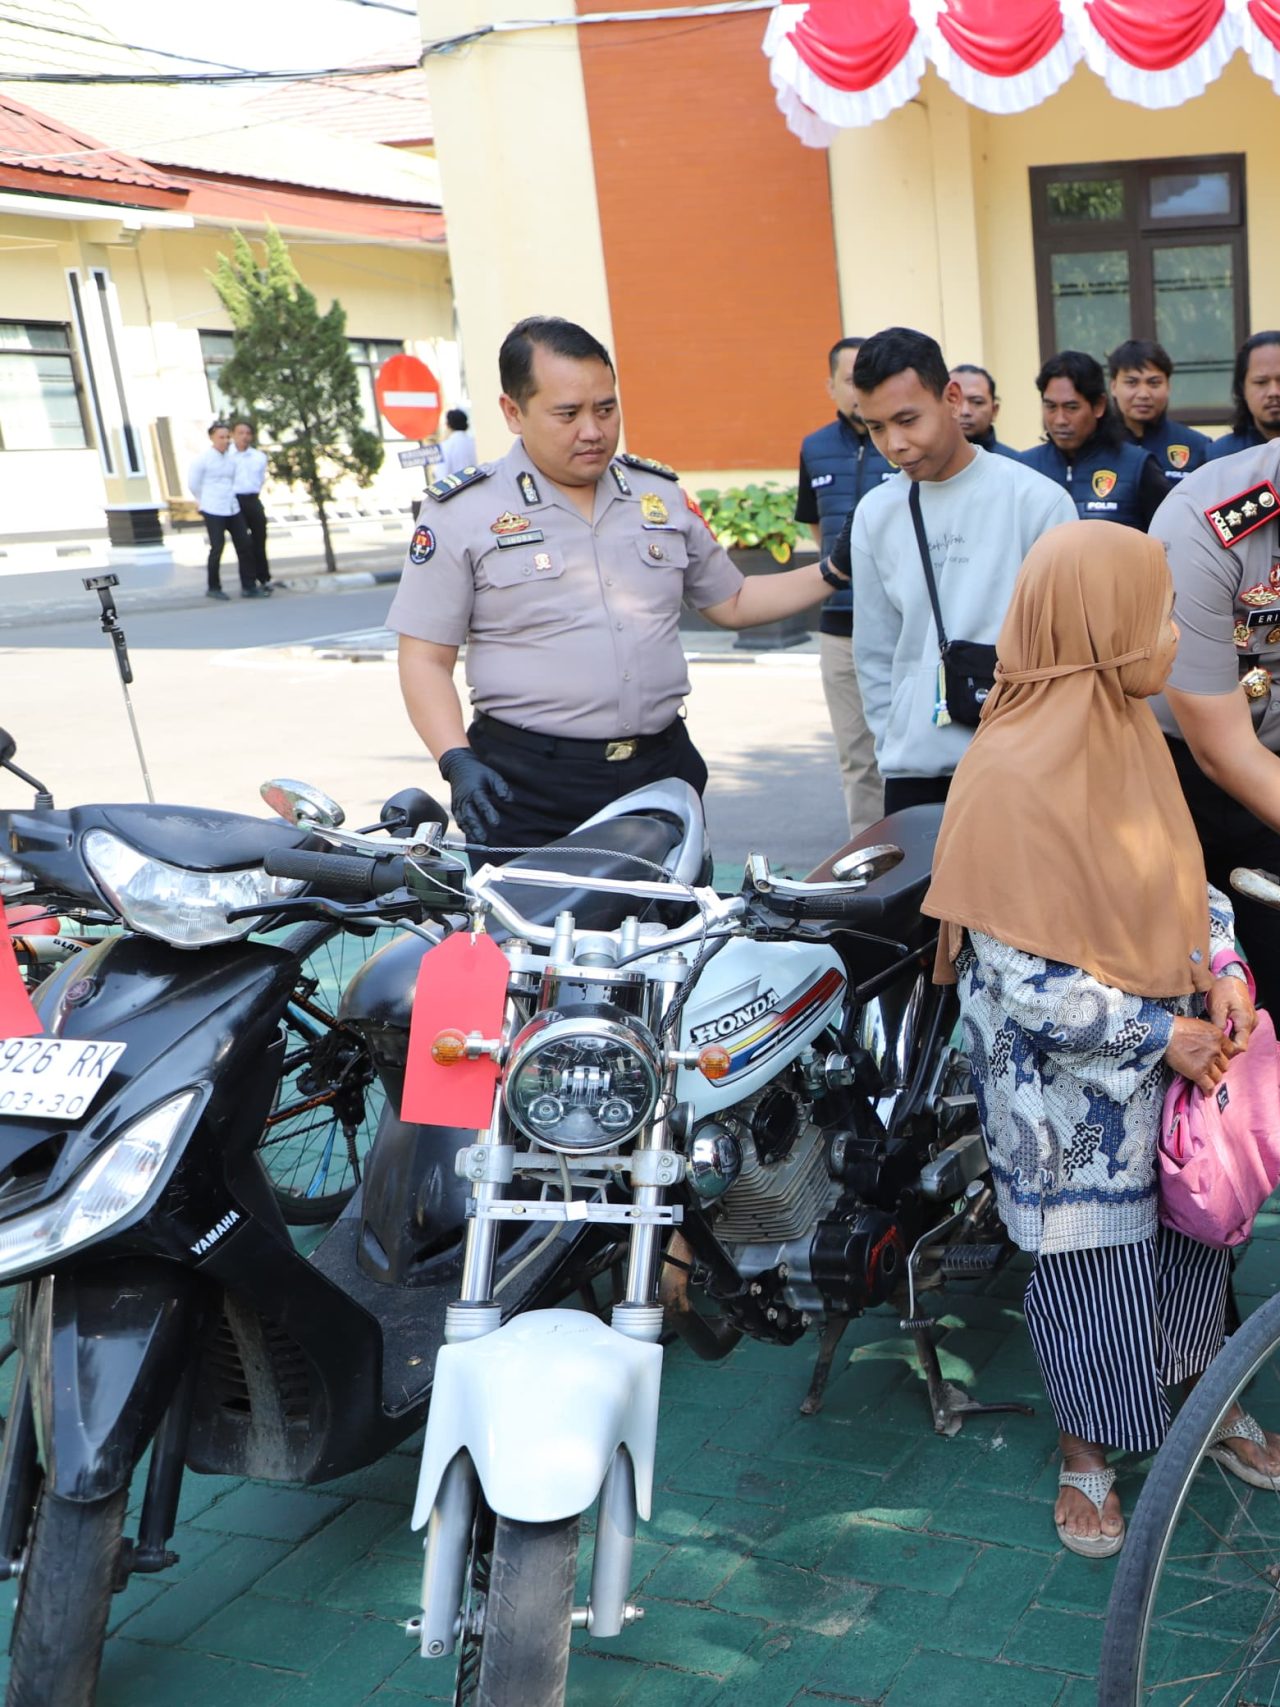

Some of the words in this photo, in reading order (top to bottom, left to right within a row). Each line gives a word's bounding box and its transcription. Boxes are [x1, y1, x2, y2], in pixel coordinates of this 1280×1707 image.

[1087, 502, 1118, 511] POLRI
[692, 987, 782, 1044] HONDA
[0, 1040, 61, 1075] 926
[67, 1044, 122, 1079] RK
[190, 1210, 241, 1255] YAMAHA
